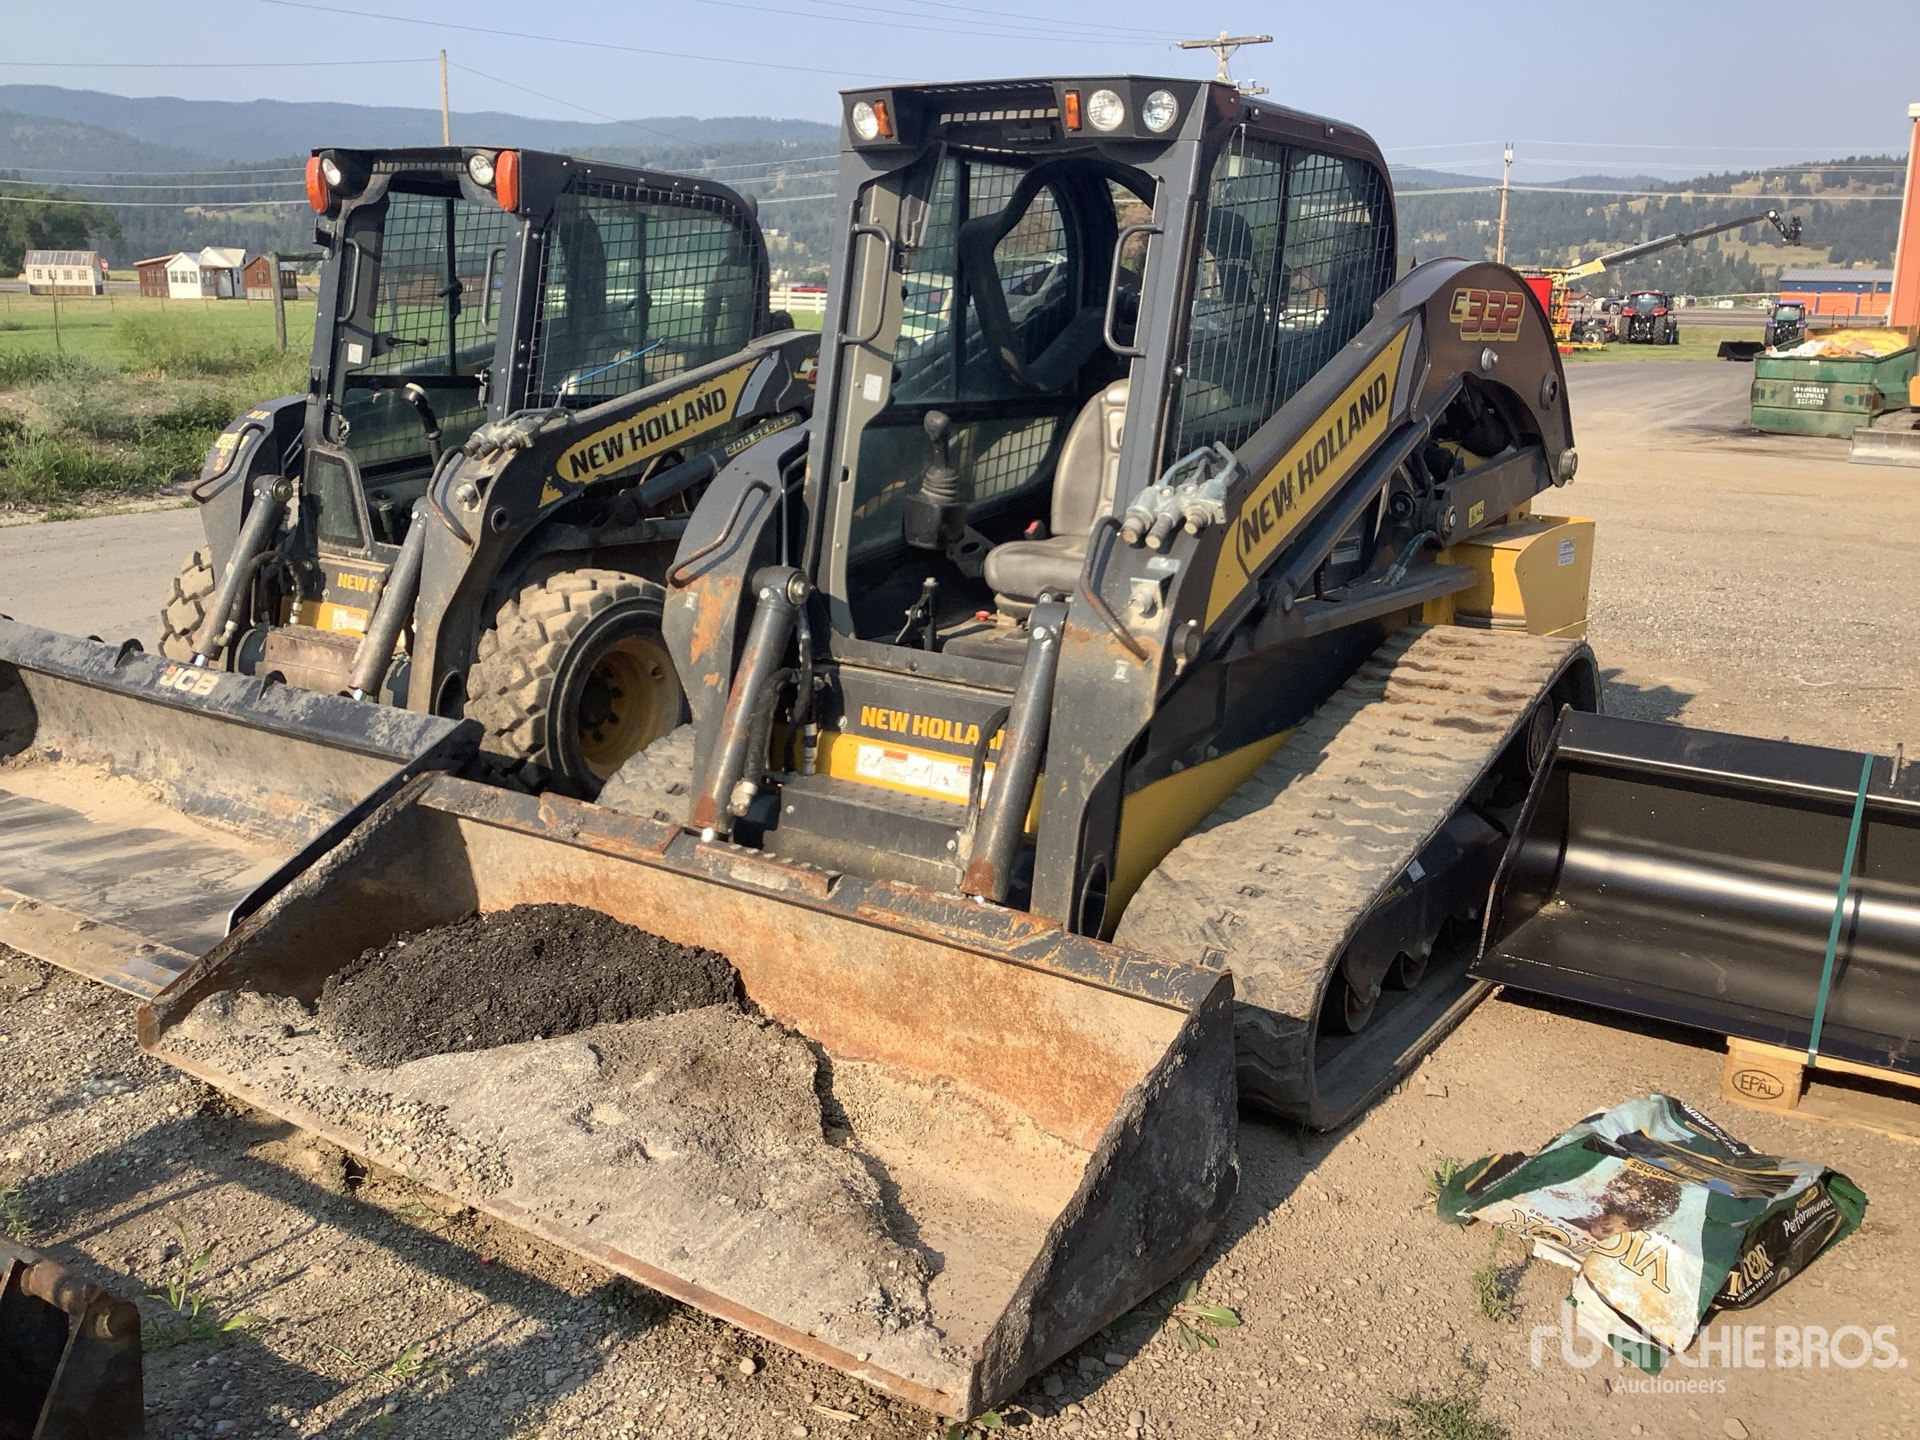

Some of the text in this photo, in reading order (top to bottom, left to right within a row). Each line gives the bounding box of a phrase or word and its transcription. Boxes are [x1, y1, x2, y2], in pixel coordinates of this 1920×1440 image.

[1795, 392, 1826, 400] DISPOSAL
[569, 386, 727, 478] NEW HOLLAND
[750, 414, 797, 440] SERIES
[1242, 371, 1387, 554] NEW HOLLAND
[337, 572, 368, 592] NEW
[160, 669, 219, 696] JCB
[861, 706, 1006, 751] NEW HOLLAN
[1740, 1074, 1777, 1096] EPAL
